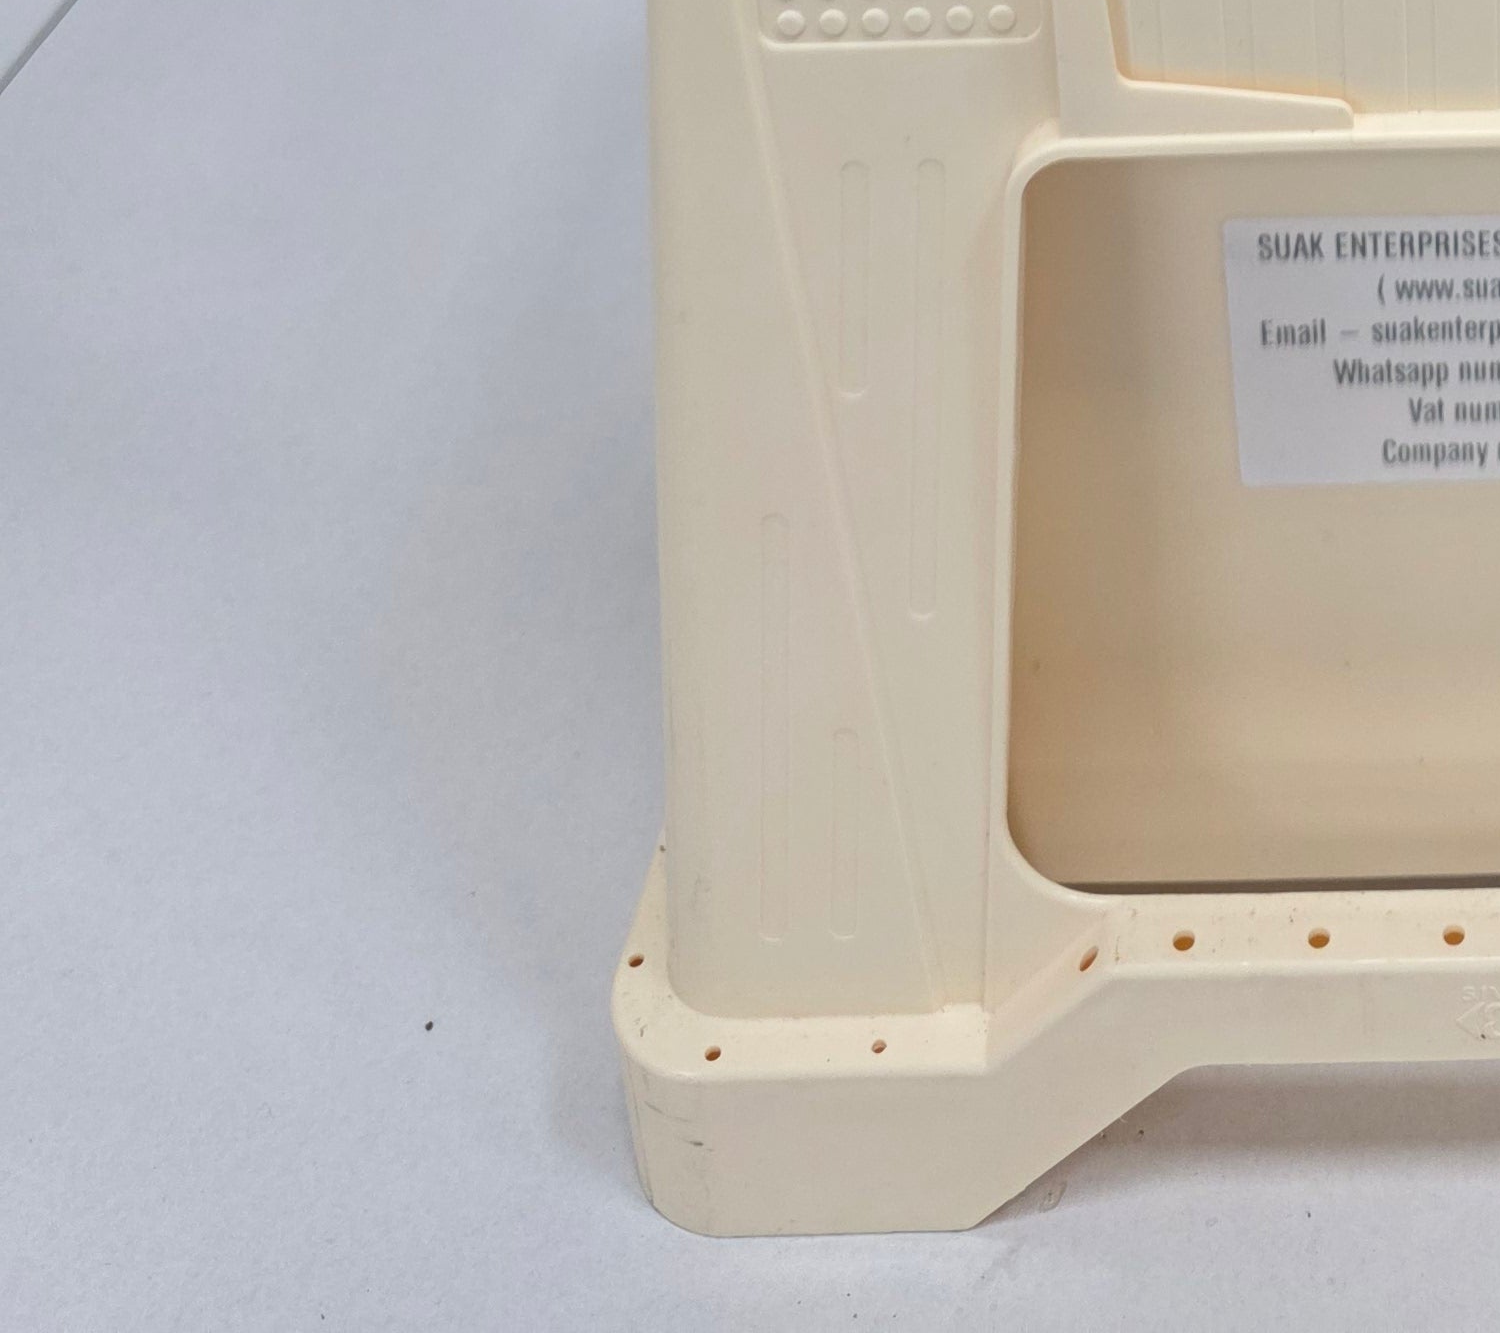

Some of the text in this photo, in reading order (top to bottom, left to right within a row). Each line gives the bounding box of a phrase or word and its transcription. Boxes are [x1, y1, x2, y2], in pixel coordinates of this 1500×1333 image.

[1257, 232, 1325, 263] SUAK
[1259, 317, 1327, 350] Email
[1332, 358, 1450, 389] Whatsapp
[1408, 397, 1445, 425] Vat
[1381, 438, 1488, 469] Company
